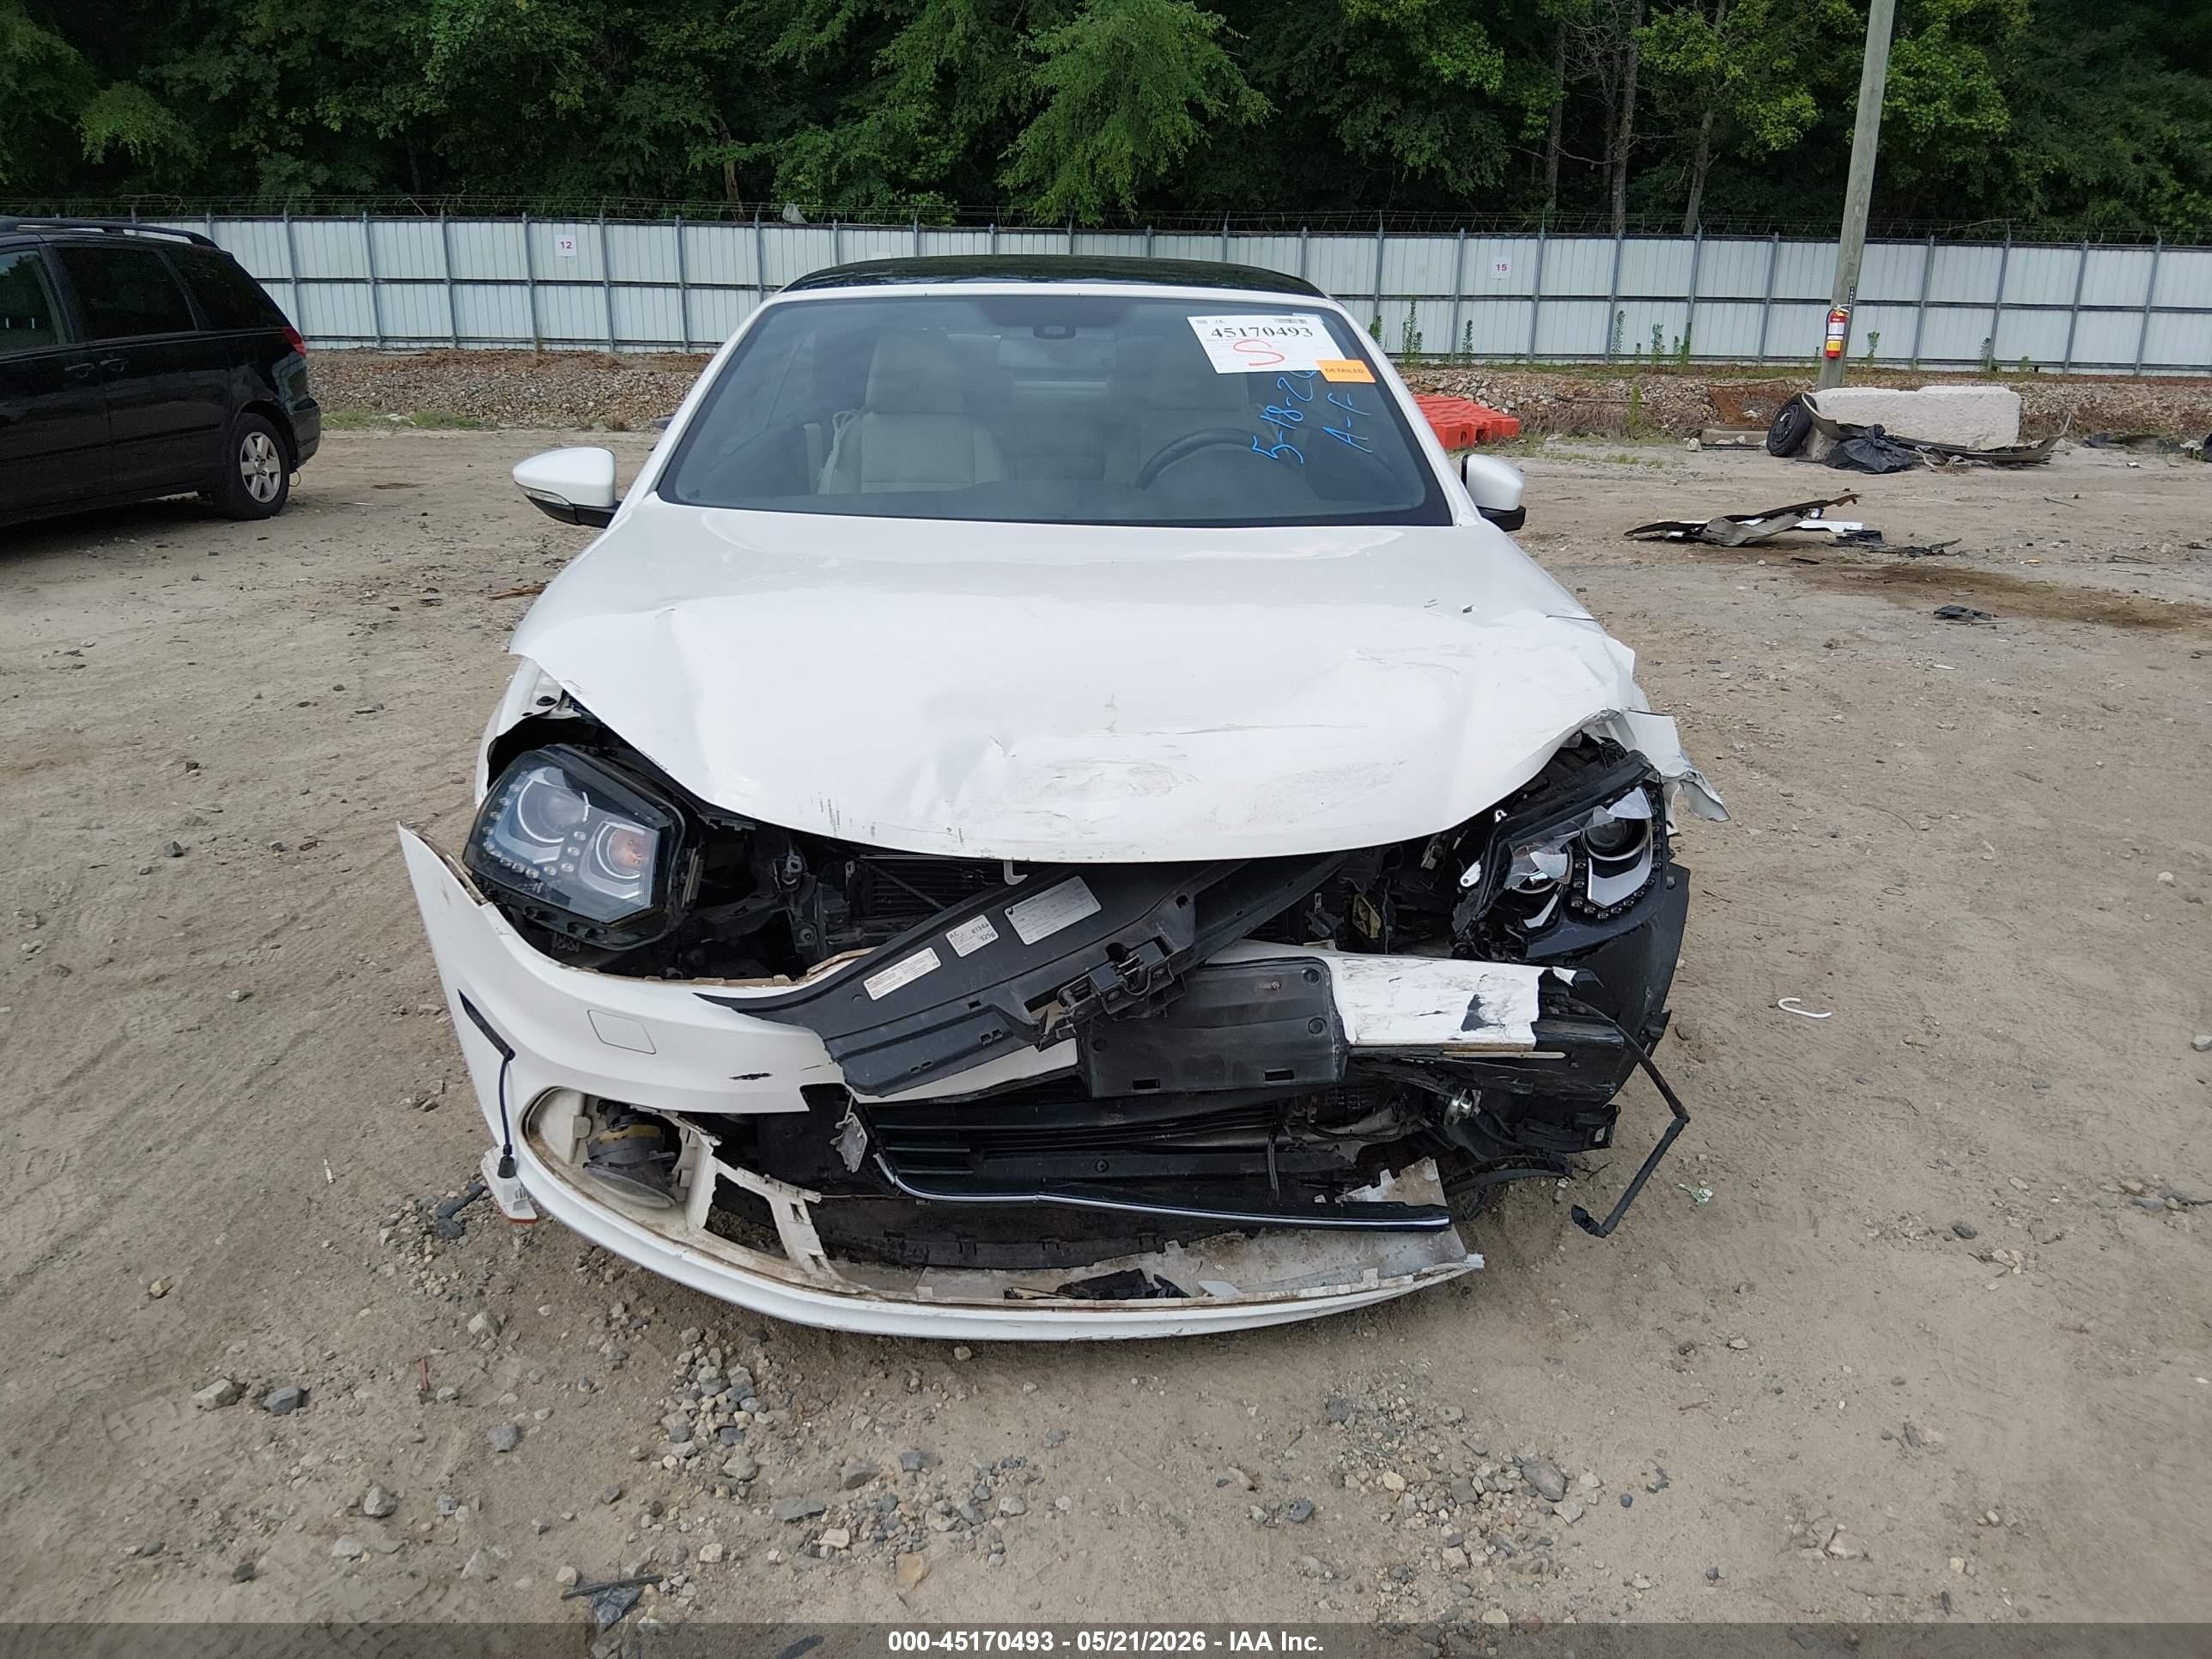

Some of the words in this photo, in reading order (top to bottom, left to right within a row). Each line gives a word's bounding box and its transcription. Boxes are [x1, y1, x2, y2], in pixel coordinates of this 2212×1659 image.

[560, 240, 573, 249] 12
[1211, 326, 1313, 338] 45170493
[1233, 339, 1285, 367] S
